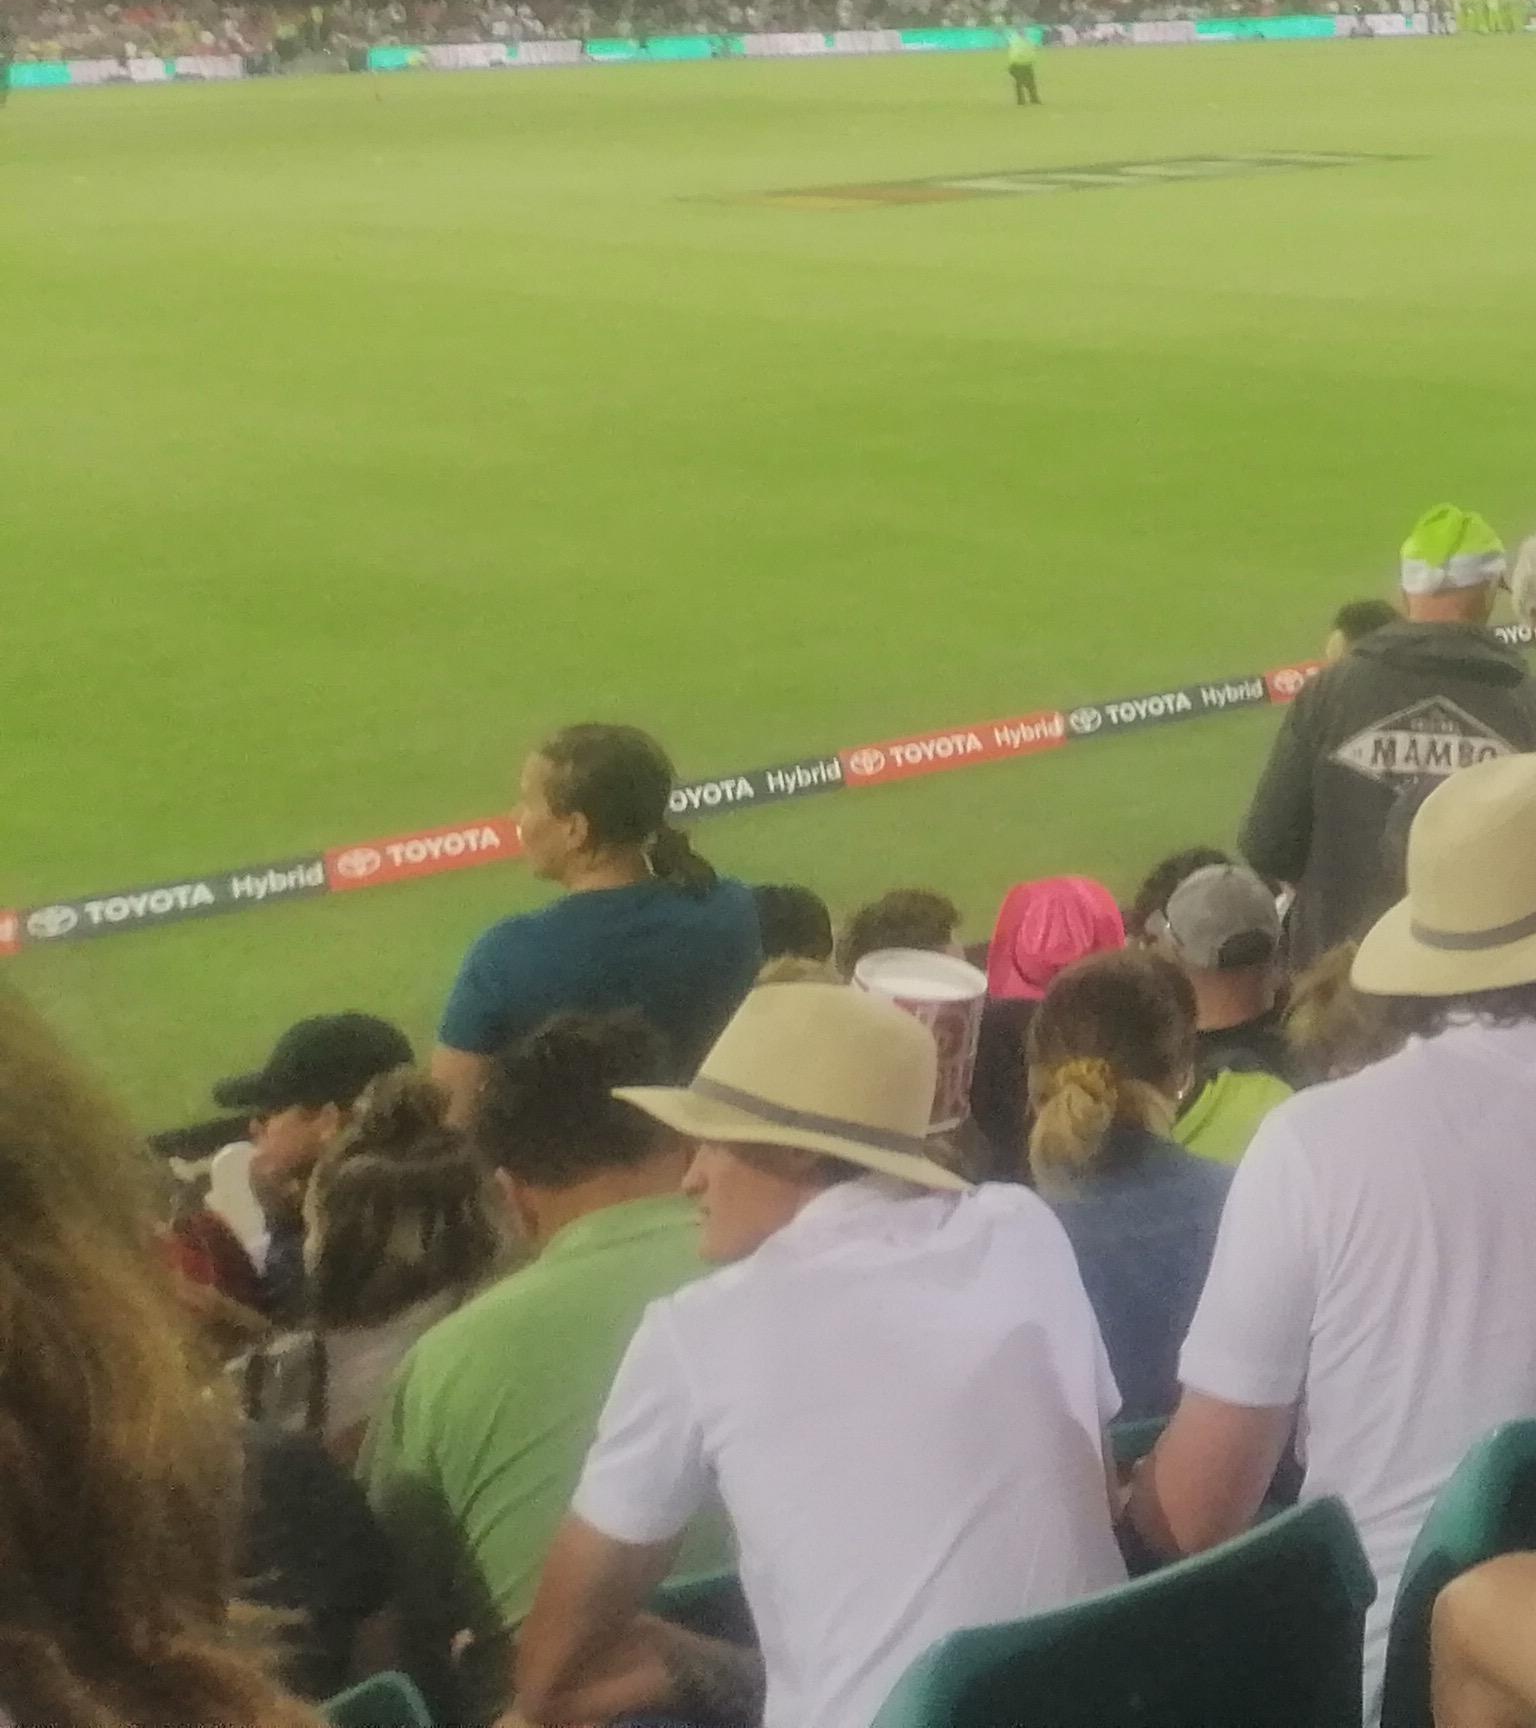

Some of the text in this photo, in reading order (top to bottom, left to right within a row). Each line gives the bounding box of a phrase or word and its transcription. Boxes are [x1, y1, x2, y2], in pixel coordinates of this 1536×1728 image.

[1104, 678, 1263, 724] TOYOTA Hybrid
[889, 711, 1065, 769] TOYOTA Hybrid
[668, 756, 843, 813] OYOTA Hybrid
[386, 826, 501, 868] TOYOTA
[84, 860, 325, 927] TOYOTA Hybrid
